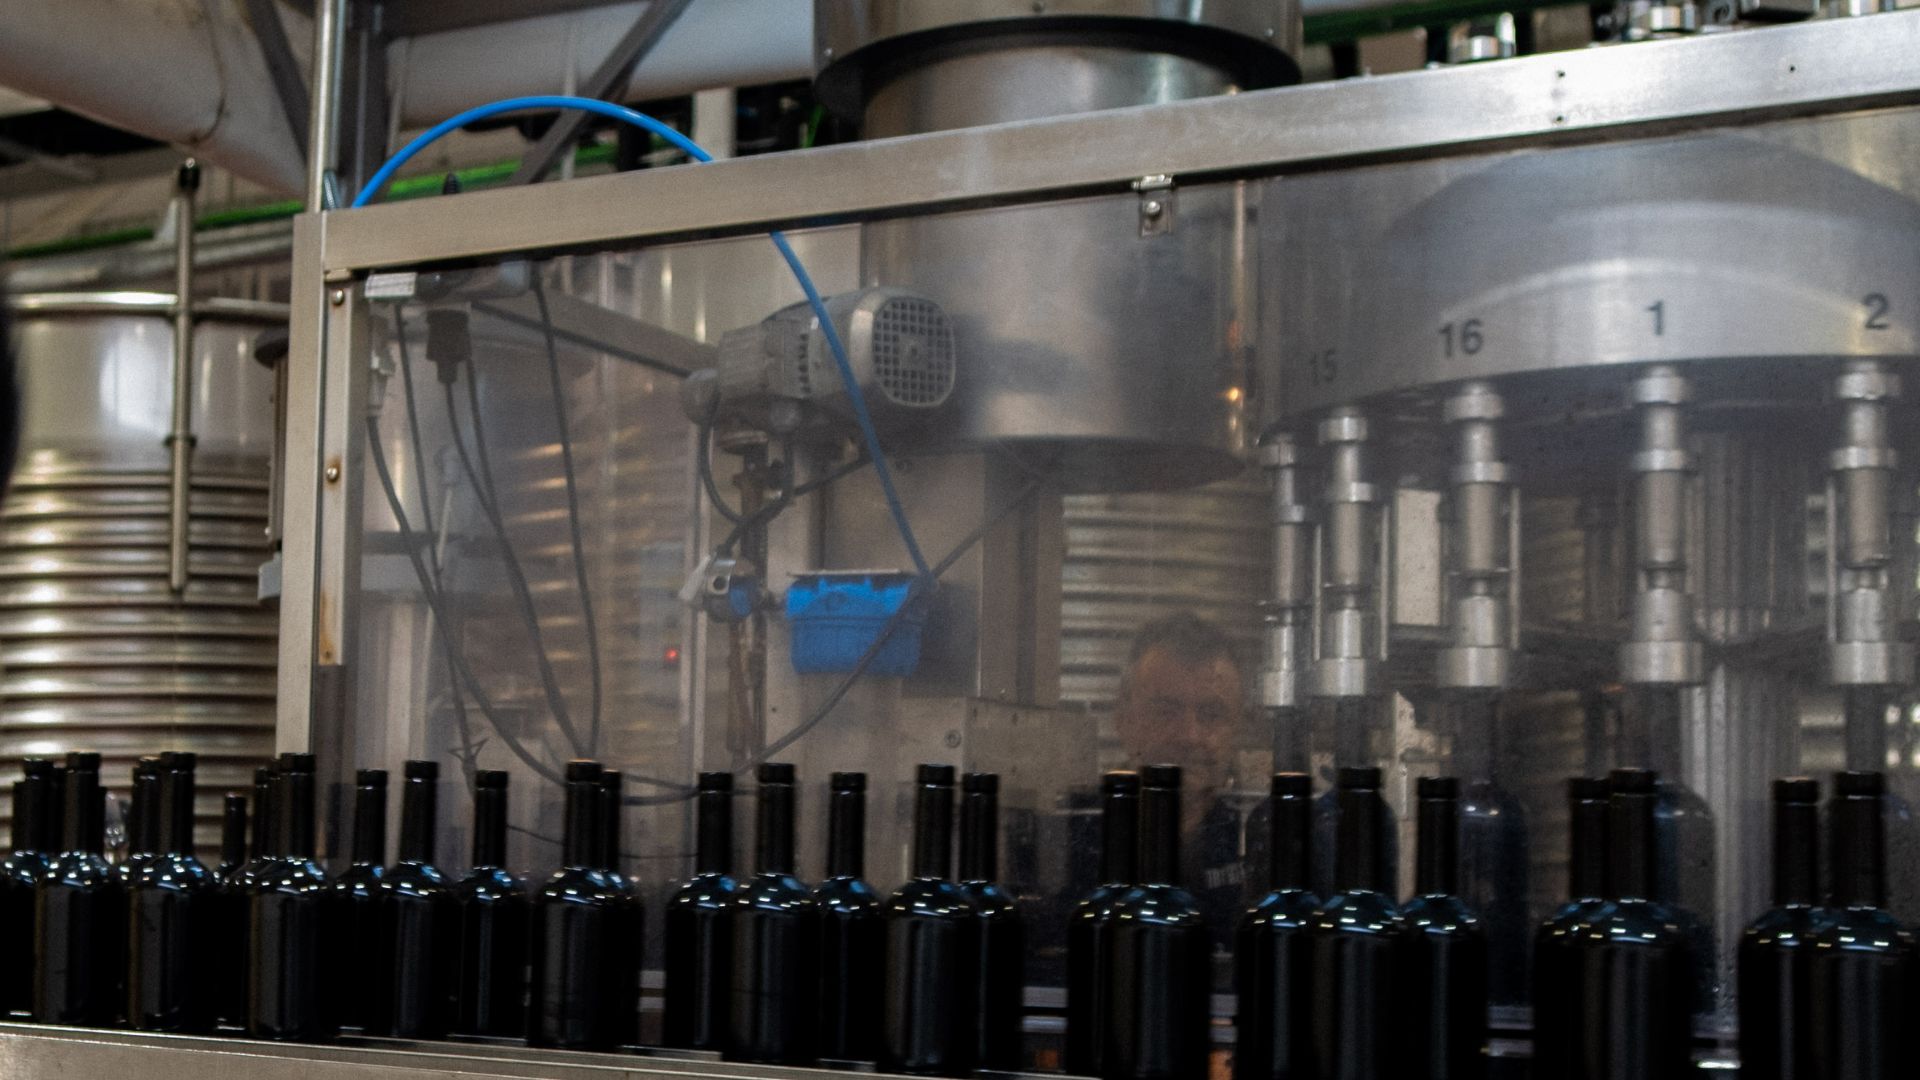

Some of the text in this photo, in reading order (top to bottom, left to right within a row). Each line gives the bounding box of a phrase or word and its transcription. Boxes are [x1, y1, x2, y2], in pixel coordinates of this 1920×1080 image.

[1647, 300, 1665, 337] 1
[1864, 292, 1888, 330] 2
[1438, 319, 1484, 358] 16
[1309, 350, 1338, 386] 15
